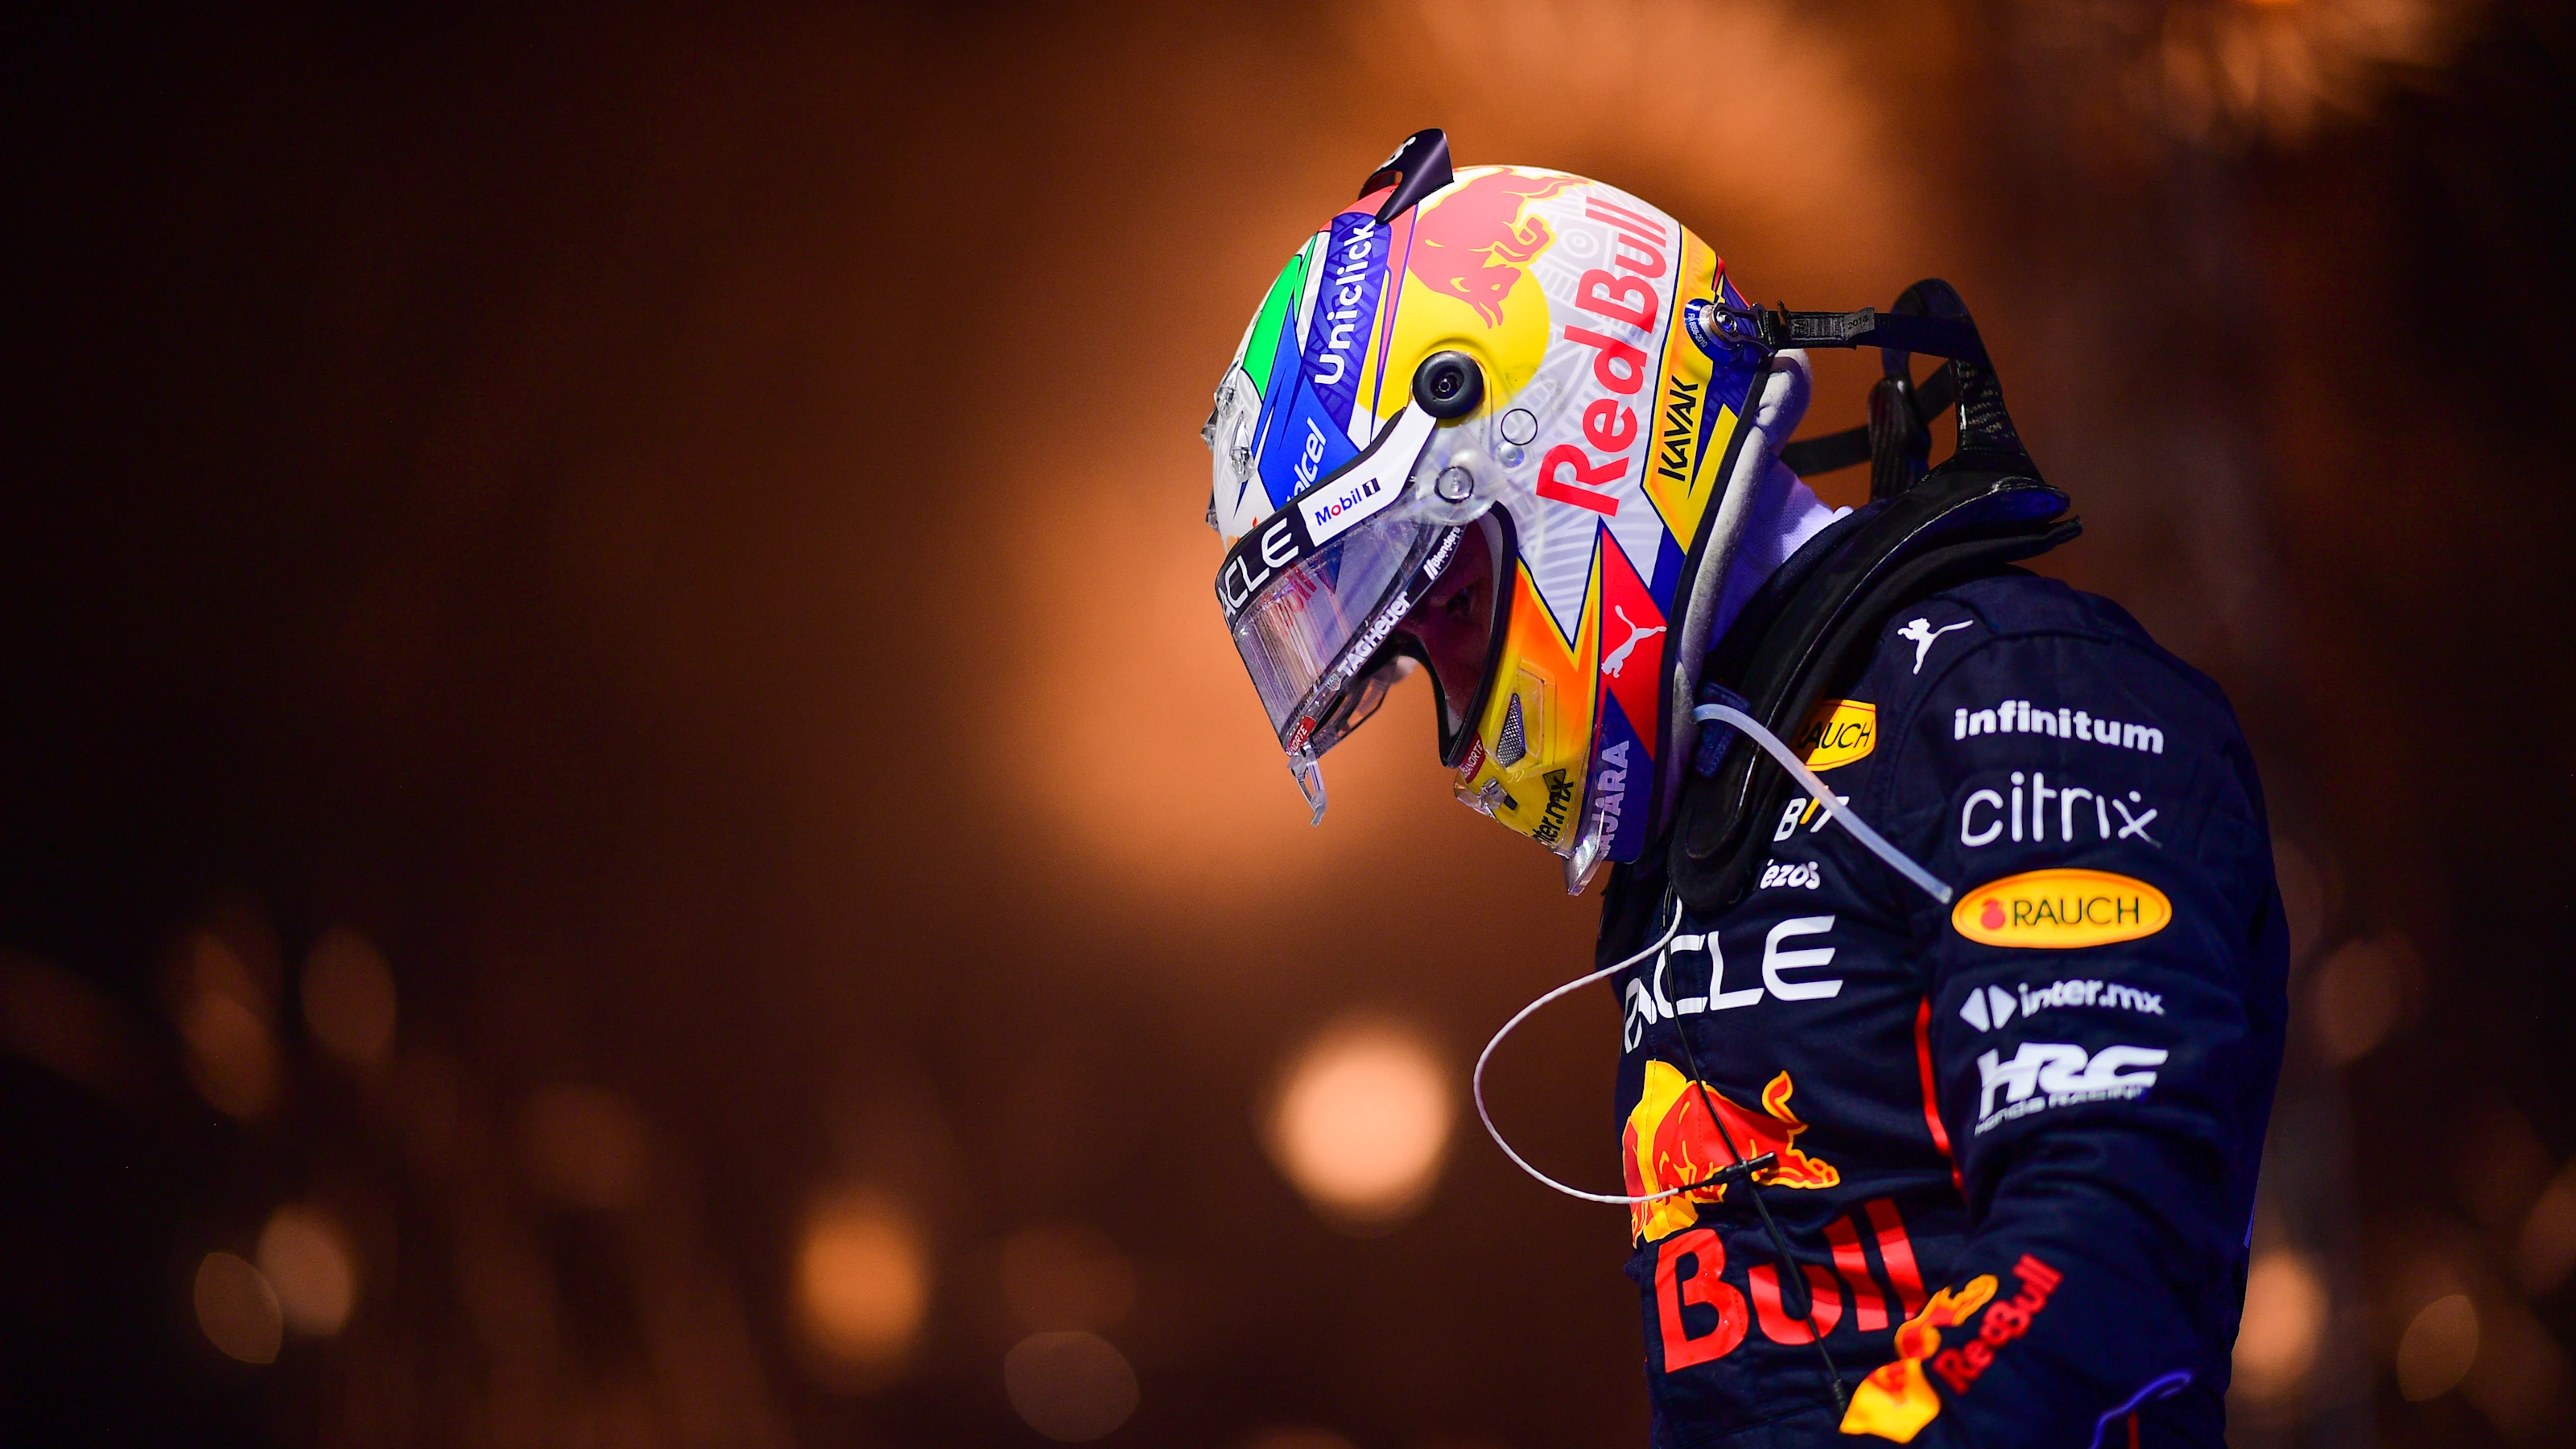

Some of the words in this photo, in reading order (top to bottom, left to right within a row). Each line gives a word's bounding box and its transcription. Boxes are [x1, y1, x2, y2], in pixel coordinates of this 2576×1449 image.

[1314, 219, 1377, 386] Uniclick
[1847, 315, 1868, 330] 2014
[1657, 374, 1699, 482] KAVAK
[1315, 488, 1362, 526] Mobil
[1955, 700, 2165, 754] infinitum
[1961, 770, 2162, 848] citrix
[1760, 858, 1821, 890] ezos
[2013, 897, 2139, 927] RAUCH
[2017, 979, 2166, 1019] inter.mx
[1977, 1042, 2169, 1121] HRC
[1655, 1198, 1930, 1373] Bull
